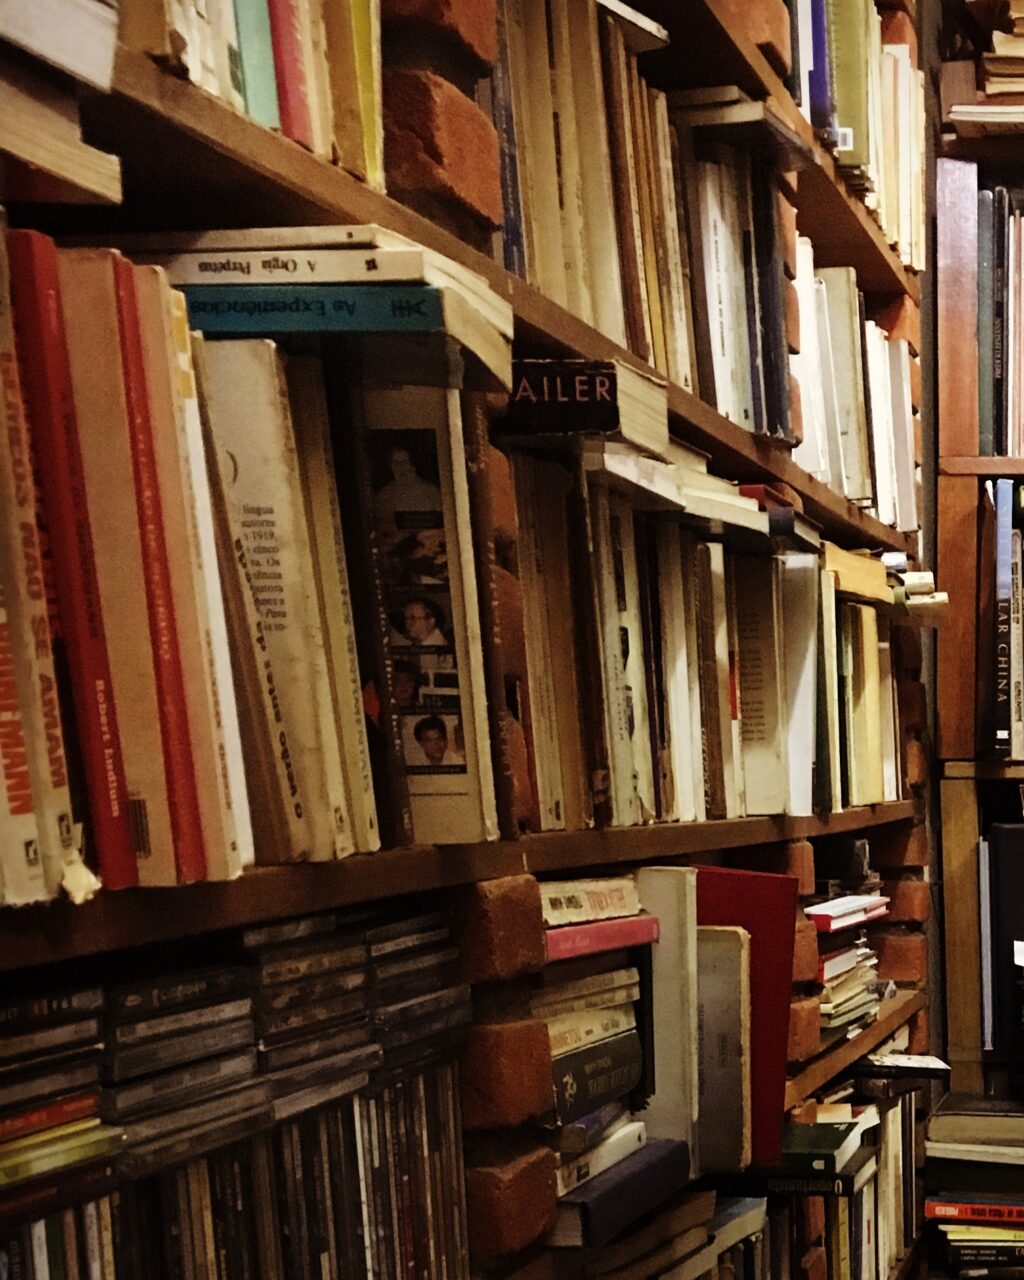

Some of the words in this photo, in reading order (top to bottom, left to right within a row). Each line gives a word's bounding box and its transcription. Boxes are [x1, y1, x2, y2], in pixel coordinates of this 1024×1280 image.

[262, 256, 297, 273] Orgia
[515, 375, 611, 402] AILER
[997, 602, 1010, 633] LAR
[997, 643, 1009, 703] CHINA
[95, 679, 111, 742] Robert
[103, 747, 120, 818] Ludlum
